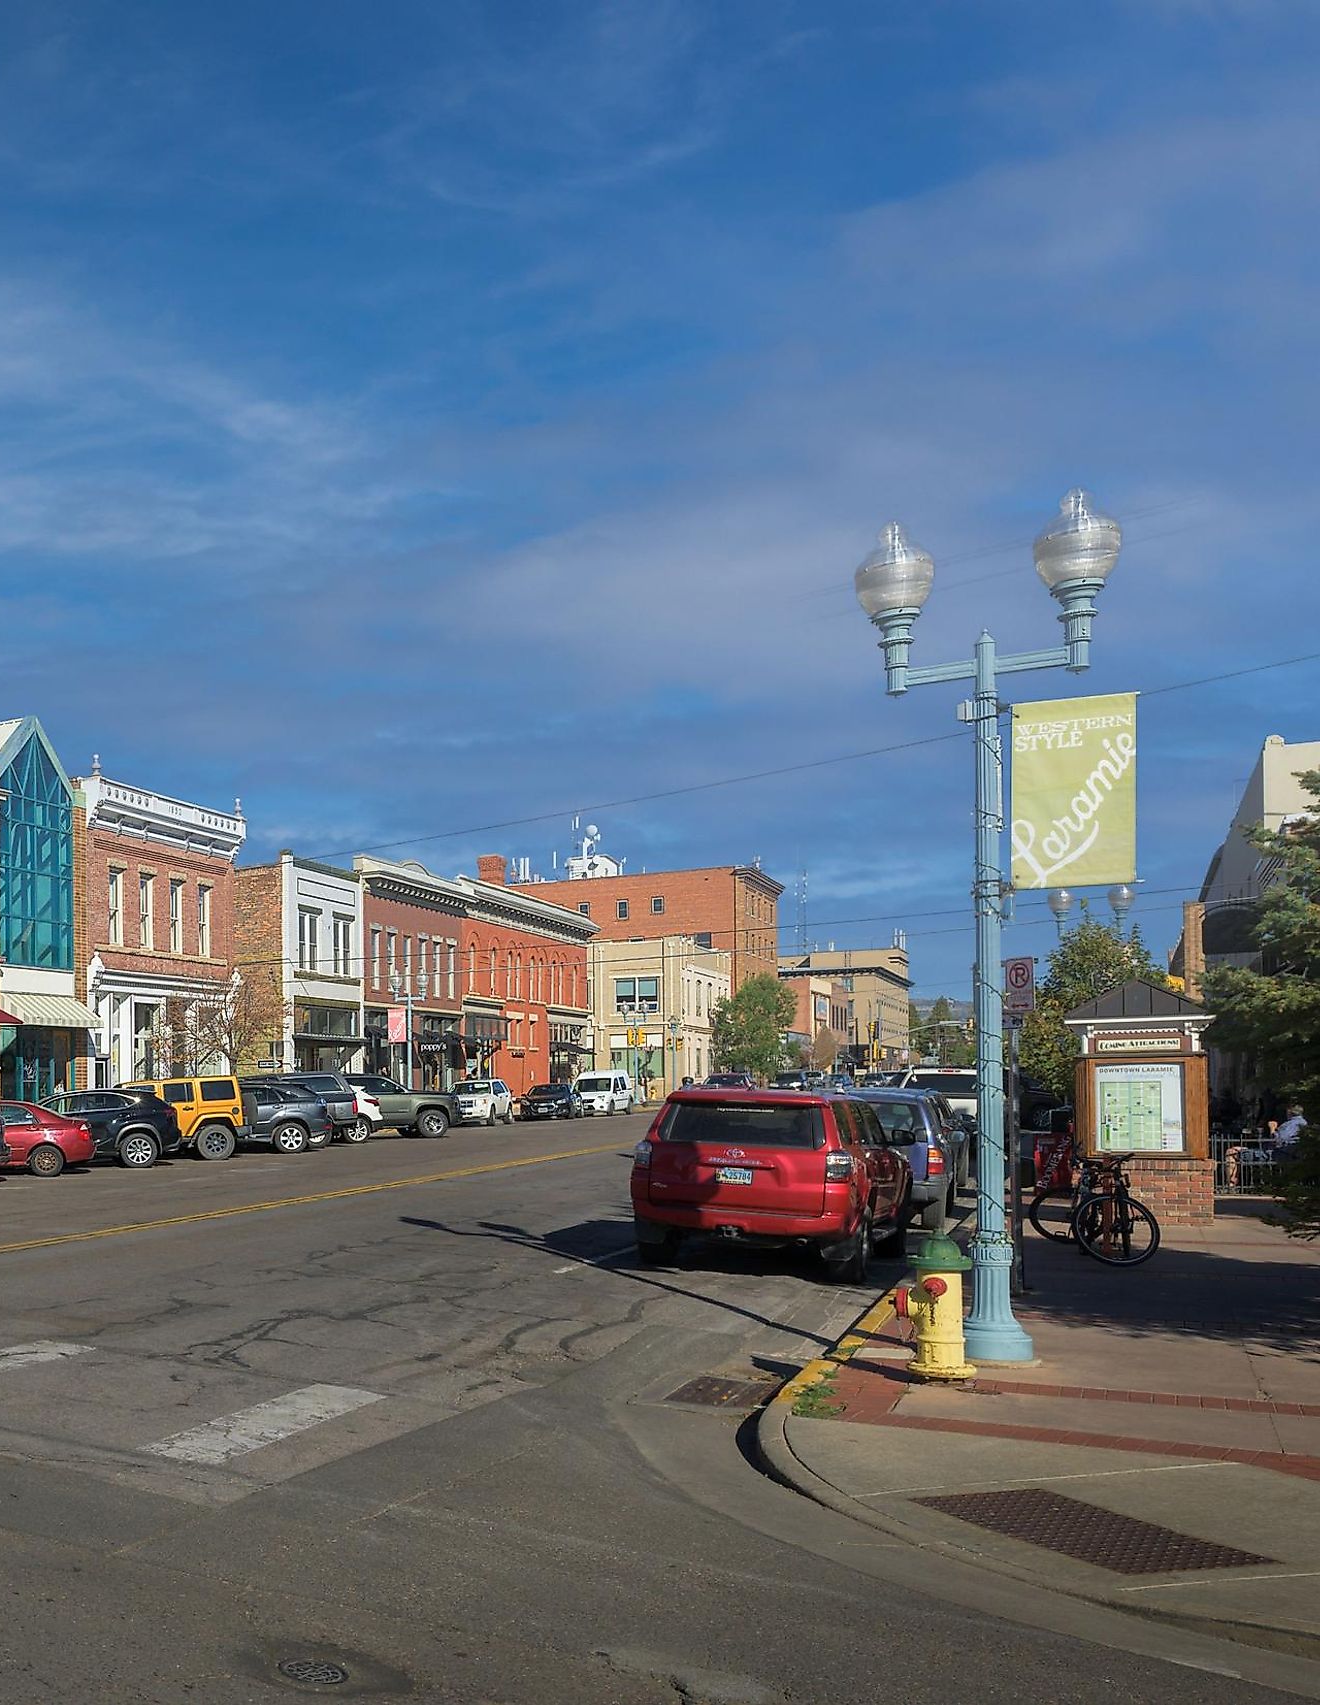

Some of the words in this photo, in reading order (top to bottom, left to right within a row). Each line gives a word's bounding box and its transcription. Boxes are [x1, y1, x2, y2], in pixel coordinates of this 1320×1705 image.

[1016, 714, 1133, 736] WESTERN
[1015, 731, 1083, 752] STYLE
[1012, 731, 1136, 889] Laramie
[420, 1042, 448, 1051] poppy's
[1099, 1042, 1126, 1050] COMING
